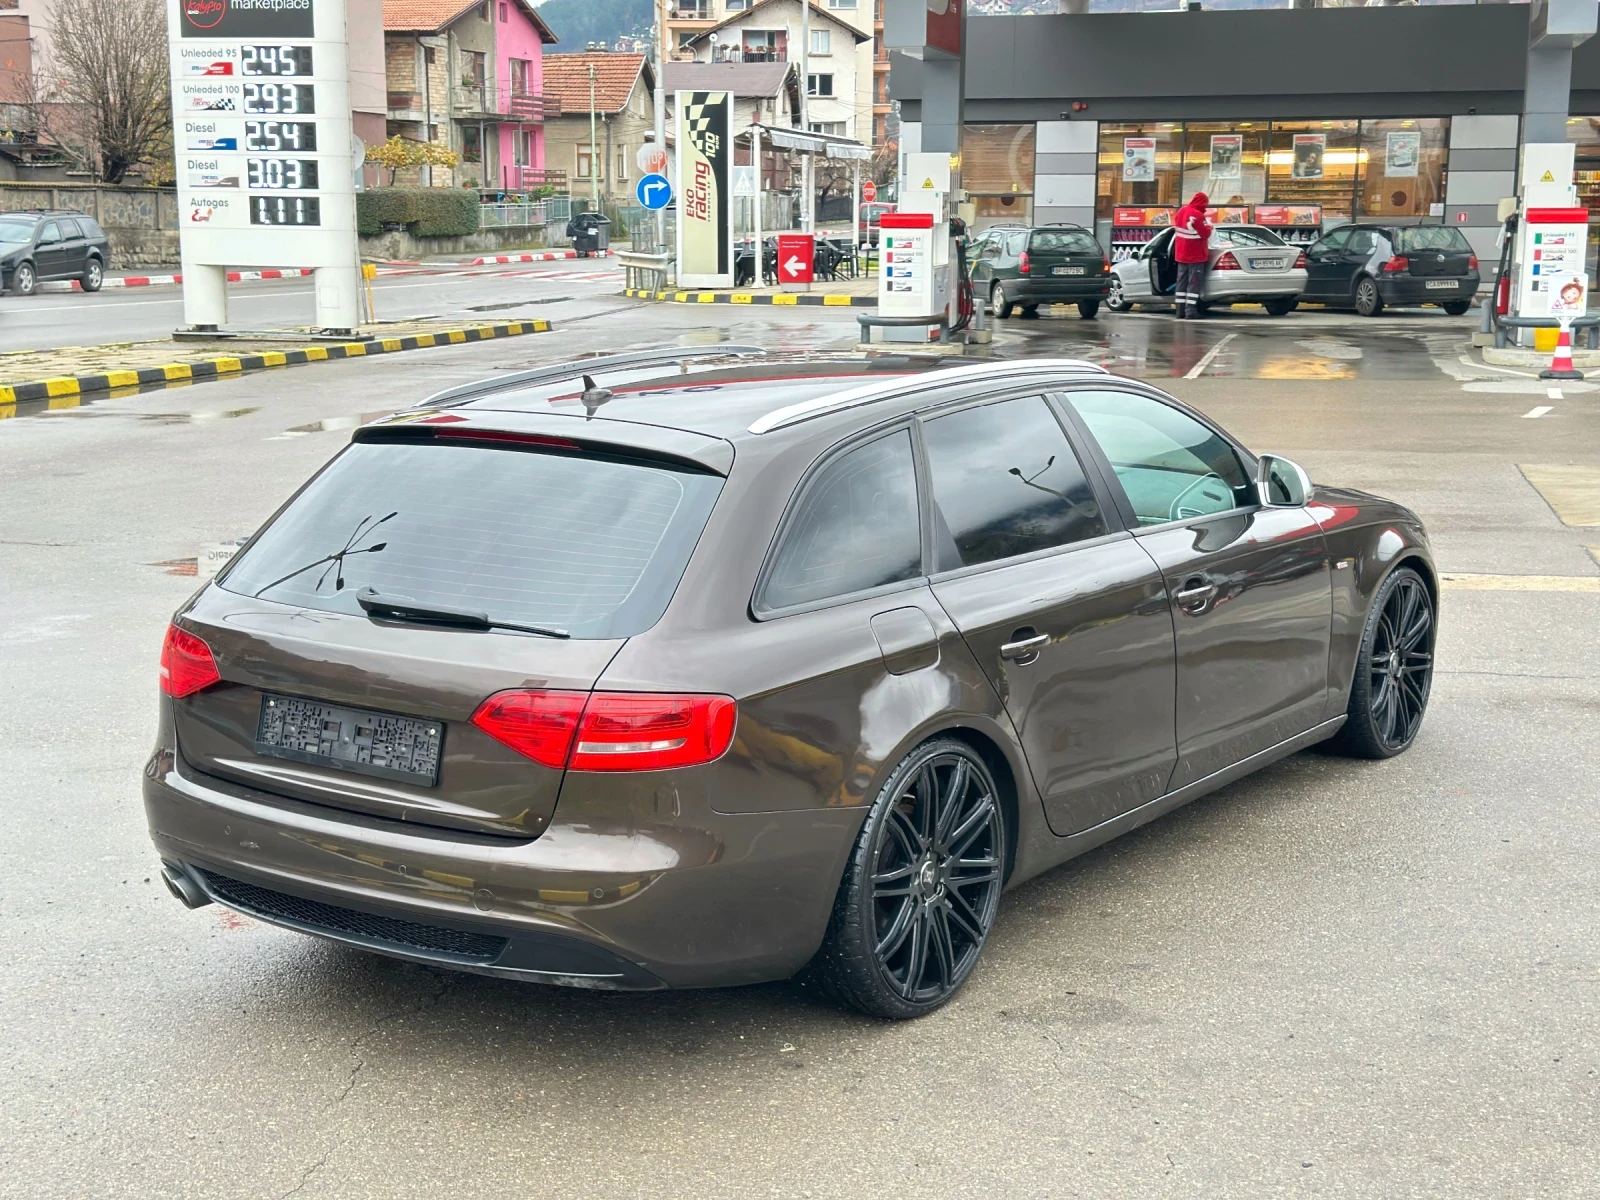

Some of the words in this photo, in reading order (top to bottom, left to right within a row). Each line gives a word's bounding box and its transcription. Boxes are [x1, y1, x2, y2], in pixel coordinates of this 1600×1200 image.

[231, 0, 309, 12] marketplace
[181, 48, 223, 58] Unleaded
[225, 49, 237, 58] 95
[242, 46, 295, 75] 2.45
[183, 85, 223, 94] Unleaded
[225, 85, 240, 94] 100
[244, 84, 298, 114] 2.93
[185, 123, 216, 133] Diesel
[246, 121, 299, 151] 2.54
[706, 132, 716, 158] 100
[188, 160, 218, 170] Diesel
[248, 158, 301, 188] 3.03
[190, 198, 229, 209] Autogas
[686, 189, 695, 217] EKO
[695, 161, 711, 221] racing
